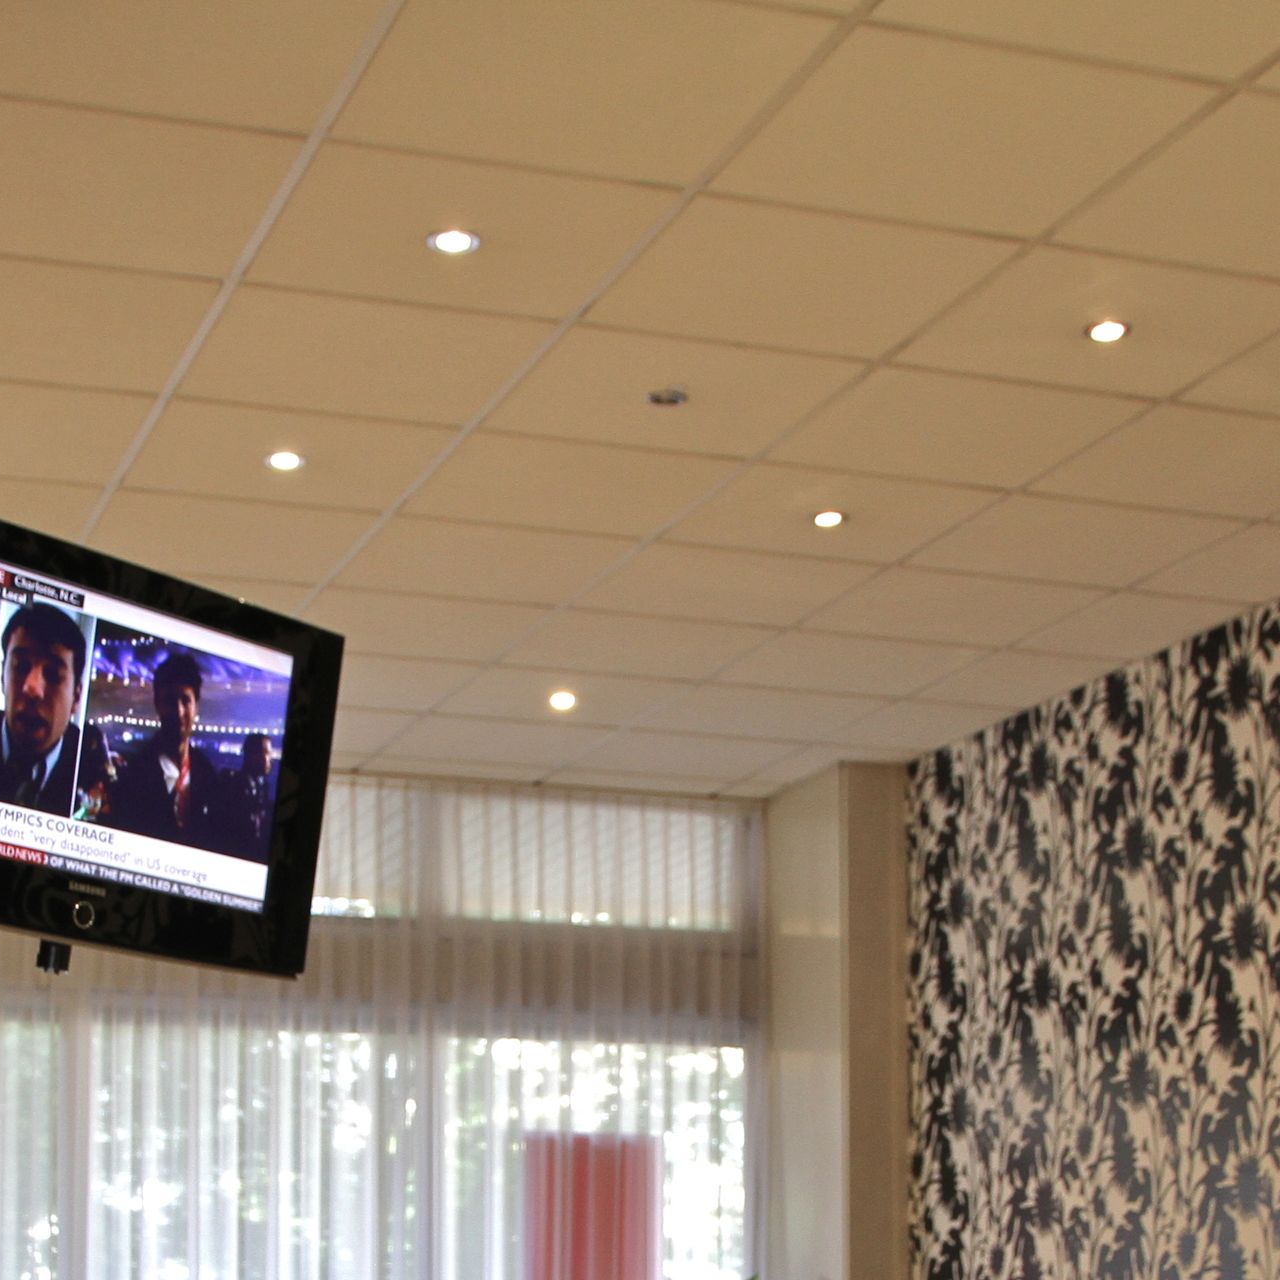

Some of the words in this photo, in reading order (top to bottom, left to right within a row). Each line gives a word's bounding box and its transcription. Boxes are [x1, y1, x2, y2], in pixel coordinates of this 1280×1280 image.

[46, 818, 115, 845] COVERAGE
[15, 847, 42, 864] NEWS
[134, 855, 144, 867] in
[146, 857, 161, 871] US
[164, 864, 208, 884] coverage
[50, 856, 64, 869] OF
[65, 858, 97, 877] WHAT
[98, 866, 119, 882] THE
[134, 873, 171, 893] CALLED
